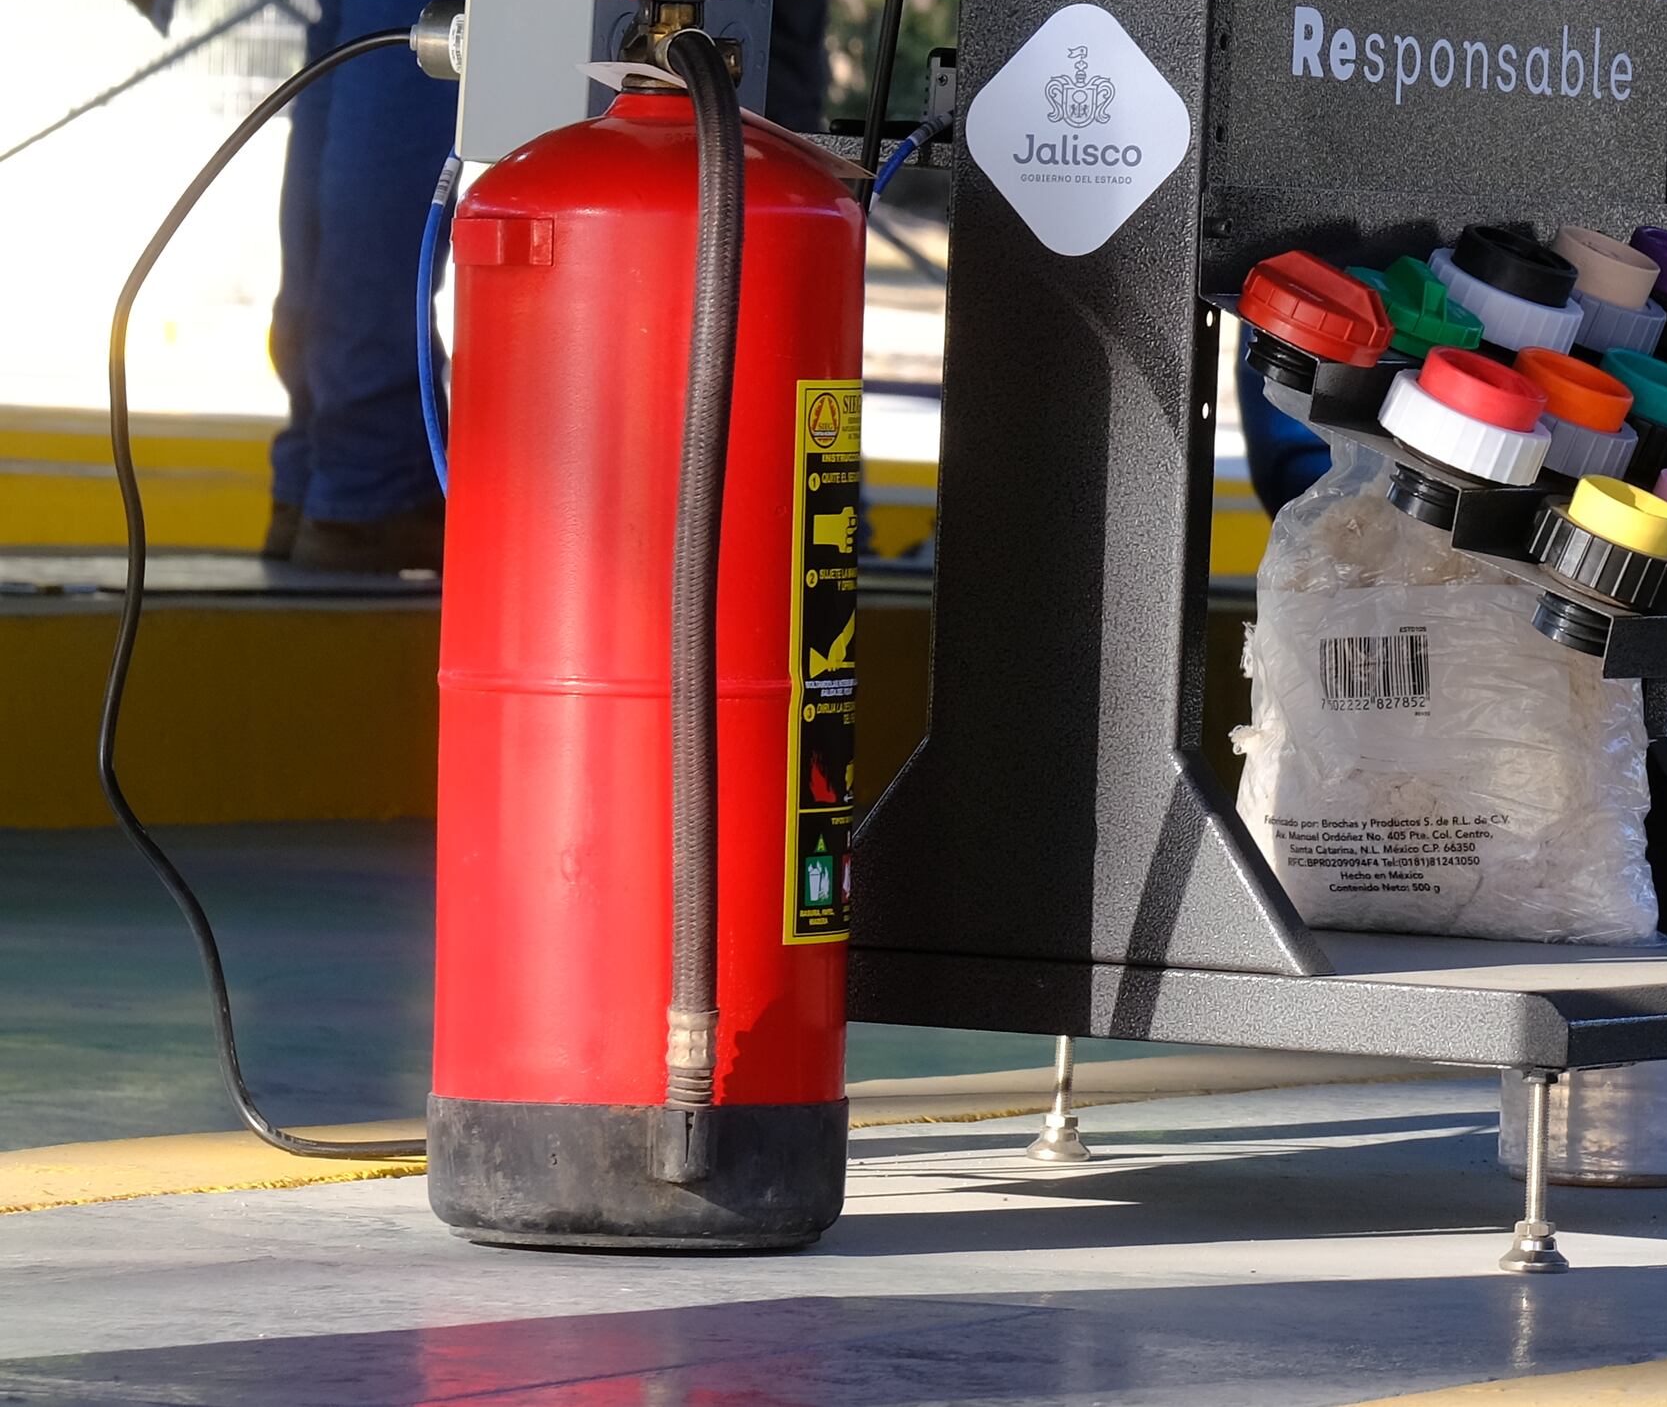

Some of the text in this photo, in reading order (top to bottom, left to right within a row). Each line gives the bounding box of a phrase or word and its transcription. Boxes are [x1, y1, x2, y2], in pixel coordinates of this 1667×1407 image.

[1292, 6, 1633, 105] Responsable
[1013, 134, 1142, 167] Jalisco
[1020, 173, 1132, 184] GOBIERNO DEL ESTADO
[1376, 696, 1426, 710] 827852
[1301, 820, 1319, 830] por:
[1321, 819, 1359, 829] Brochas
[1362, 821, 1368, 830] y
[1370, 818, 1420, 828] Productos
[1423, 816, 1434, 826] S.
[1436, 815, 1449, 826] de
[1452, 815, 1471, 825] R.L.
[1474, 815, 1488, 825] de
[1490, 814, 1511, 825] C.V.
[1288, 831, 1319, 841] Manuel
[1322, 832, 1363, 842] Ordóñez
[1366, 832, 1385, 841] No.
[1387, 831, 1406, 841] 405
[1409, 830, 1430, 840] Pte.
[1432, 830, 1452, 840] Col.
[1455, 829, 1494, 840] Centro,
[1290, 842, 1476, 855] Santa Catarina, N.L. México C.P. 66350
[1340, 870, 1424, 881] Hecho en México
[1329, 882, 1441, 894] Contenido Neto: 500 g
